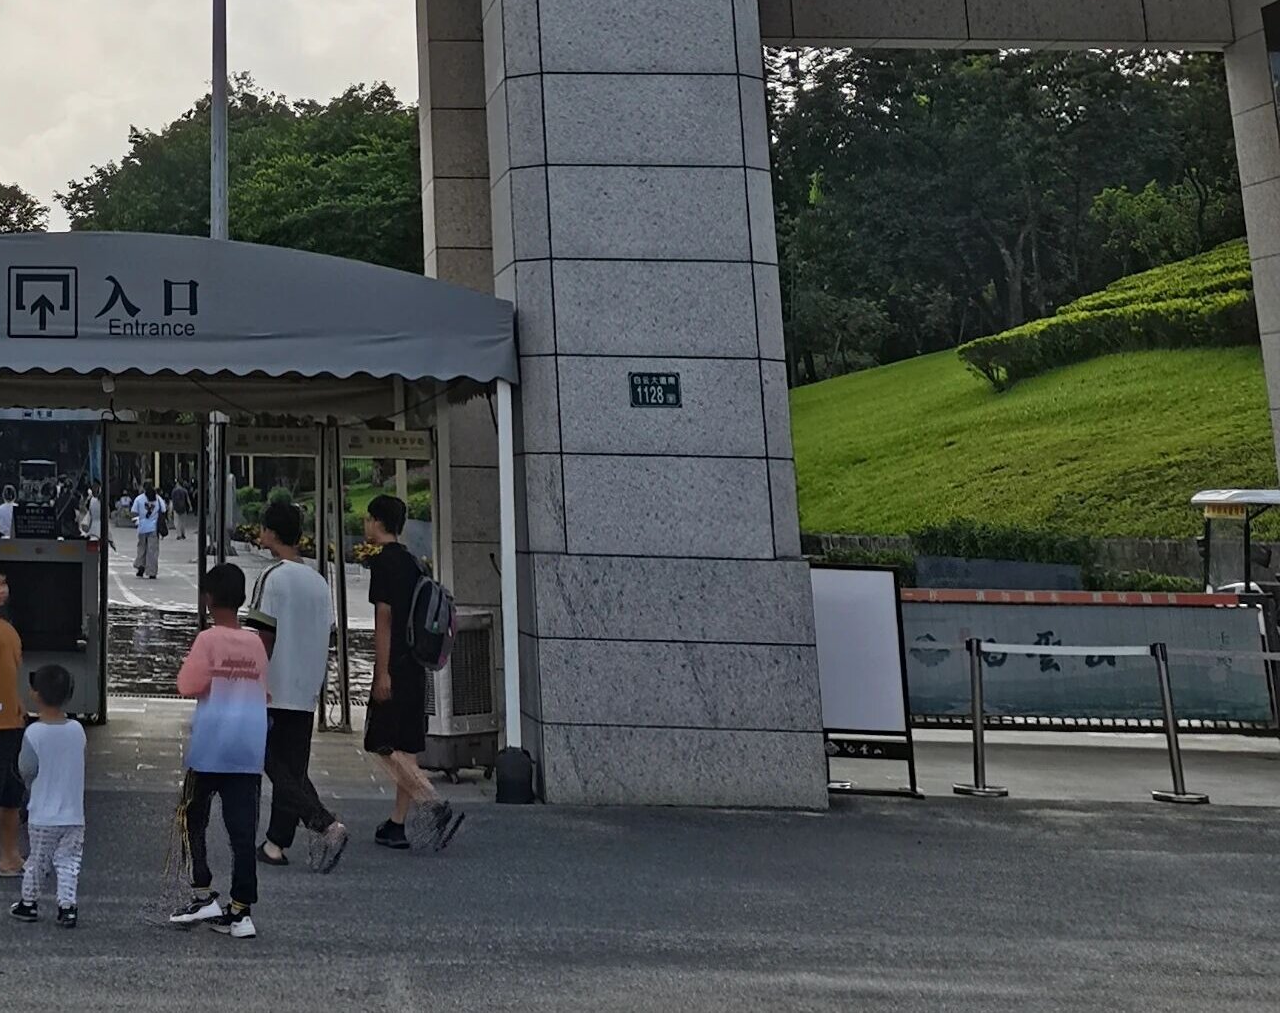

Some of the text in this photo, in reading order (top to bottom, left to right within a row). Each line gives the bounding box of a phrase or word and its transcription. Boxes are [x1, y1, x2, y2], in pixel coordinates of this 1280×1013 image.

[94, 275, 199, 319] 入口
[108, 319, 195, 336] Entrance
[637, 385, 665, 404] 1128
